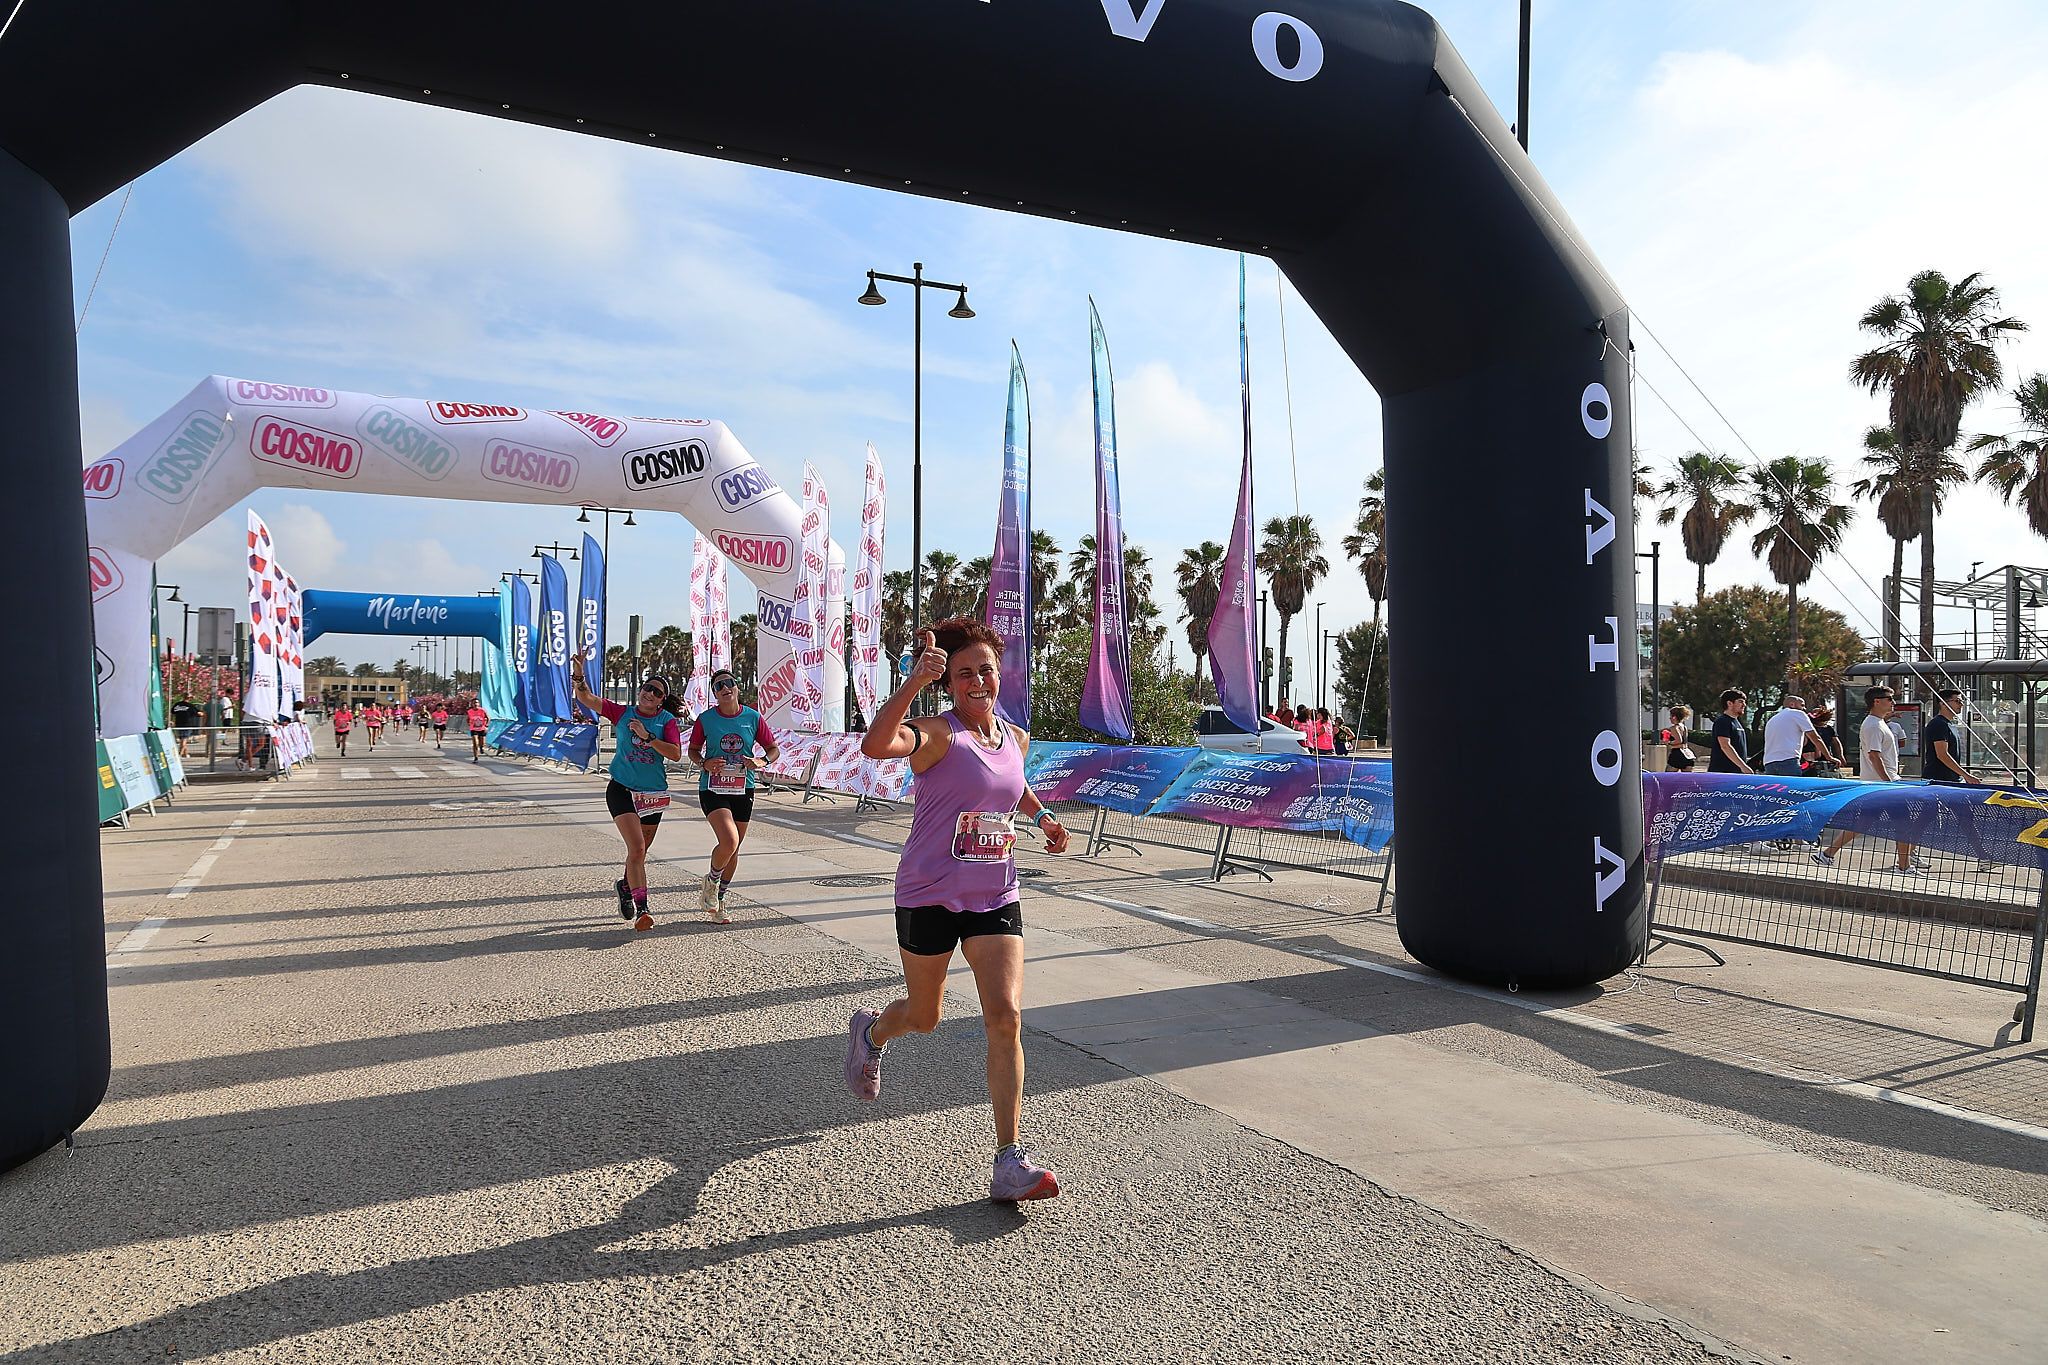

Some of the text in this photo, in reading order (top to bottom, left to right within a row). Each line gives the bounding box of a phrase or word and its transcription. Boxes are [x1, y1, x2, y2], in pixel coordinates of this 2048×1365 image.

[237, 381, 328, 403] COSMO
[146, 418, 224, 494] COSMO
[261, 423, 352, 473] COSMO
[366, 410, 450, 473] COSMO
[490, 445, 571, 487] COSMO
[631, 444, 705, 484] COSMO
[720, 466, 777, 505] COSM
[717, 534, 786, 568] COSMO
[367, 597, 448, 629] Marlene
[758, 596, 792, 634] COSM
[1580, 382, 1626, 912] VOLVO
[1192, 778, 1271, 797] CÁNCER DE MAMA
[1238, 771, 1254, 781] EL
[978, 834, 1004, 846] 016
